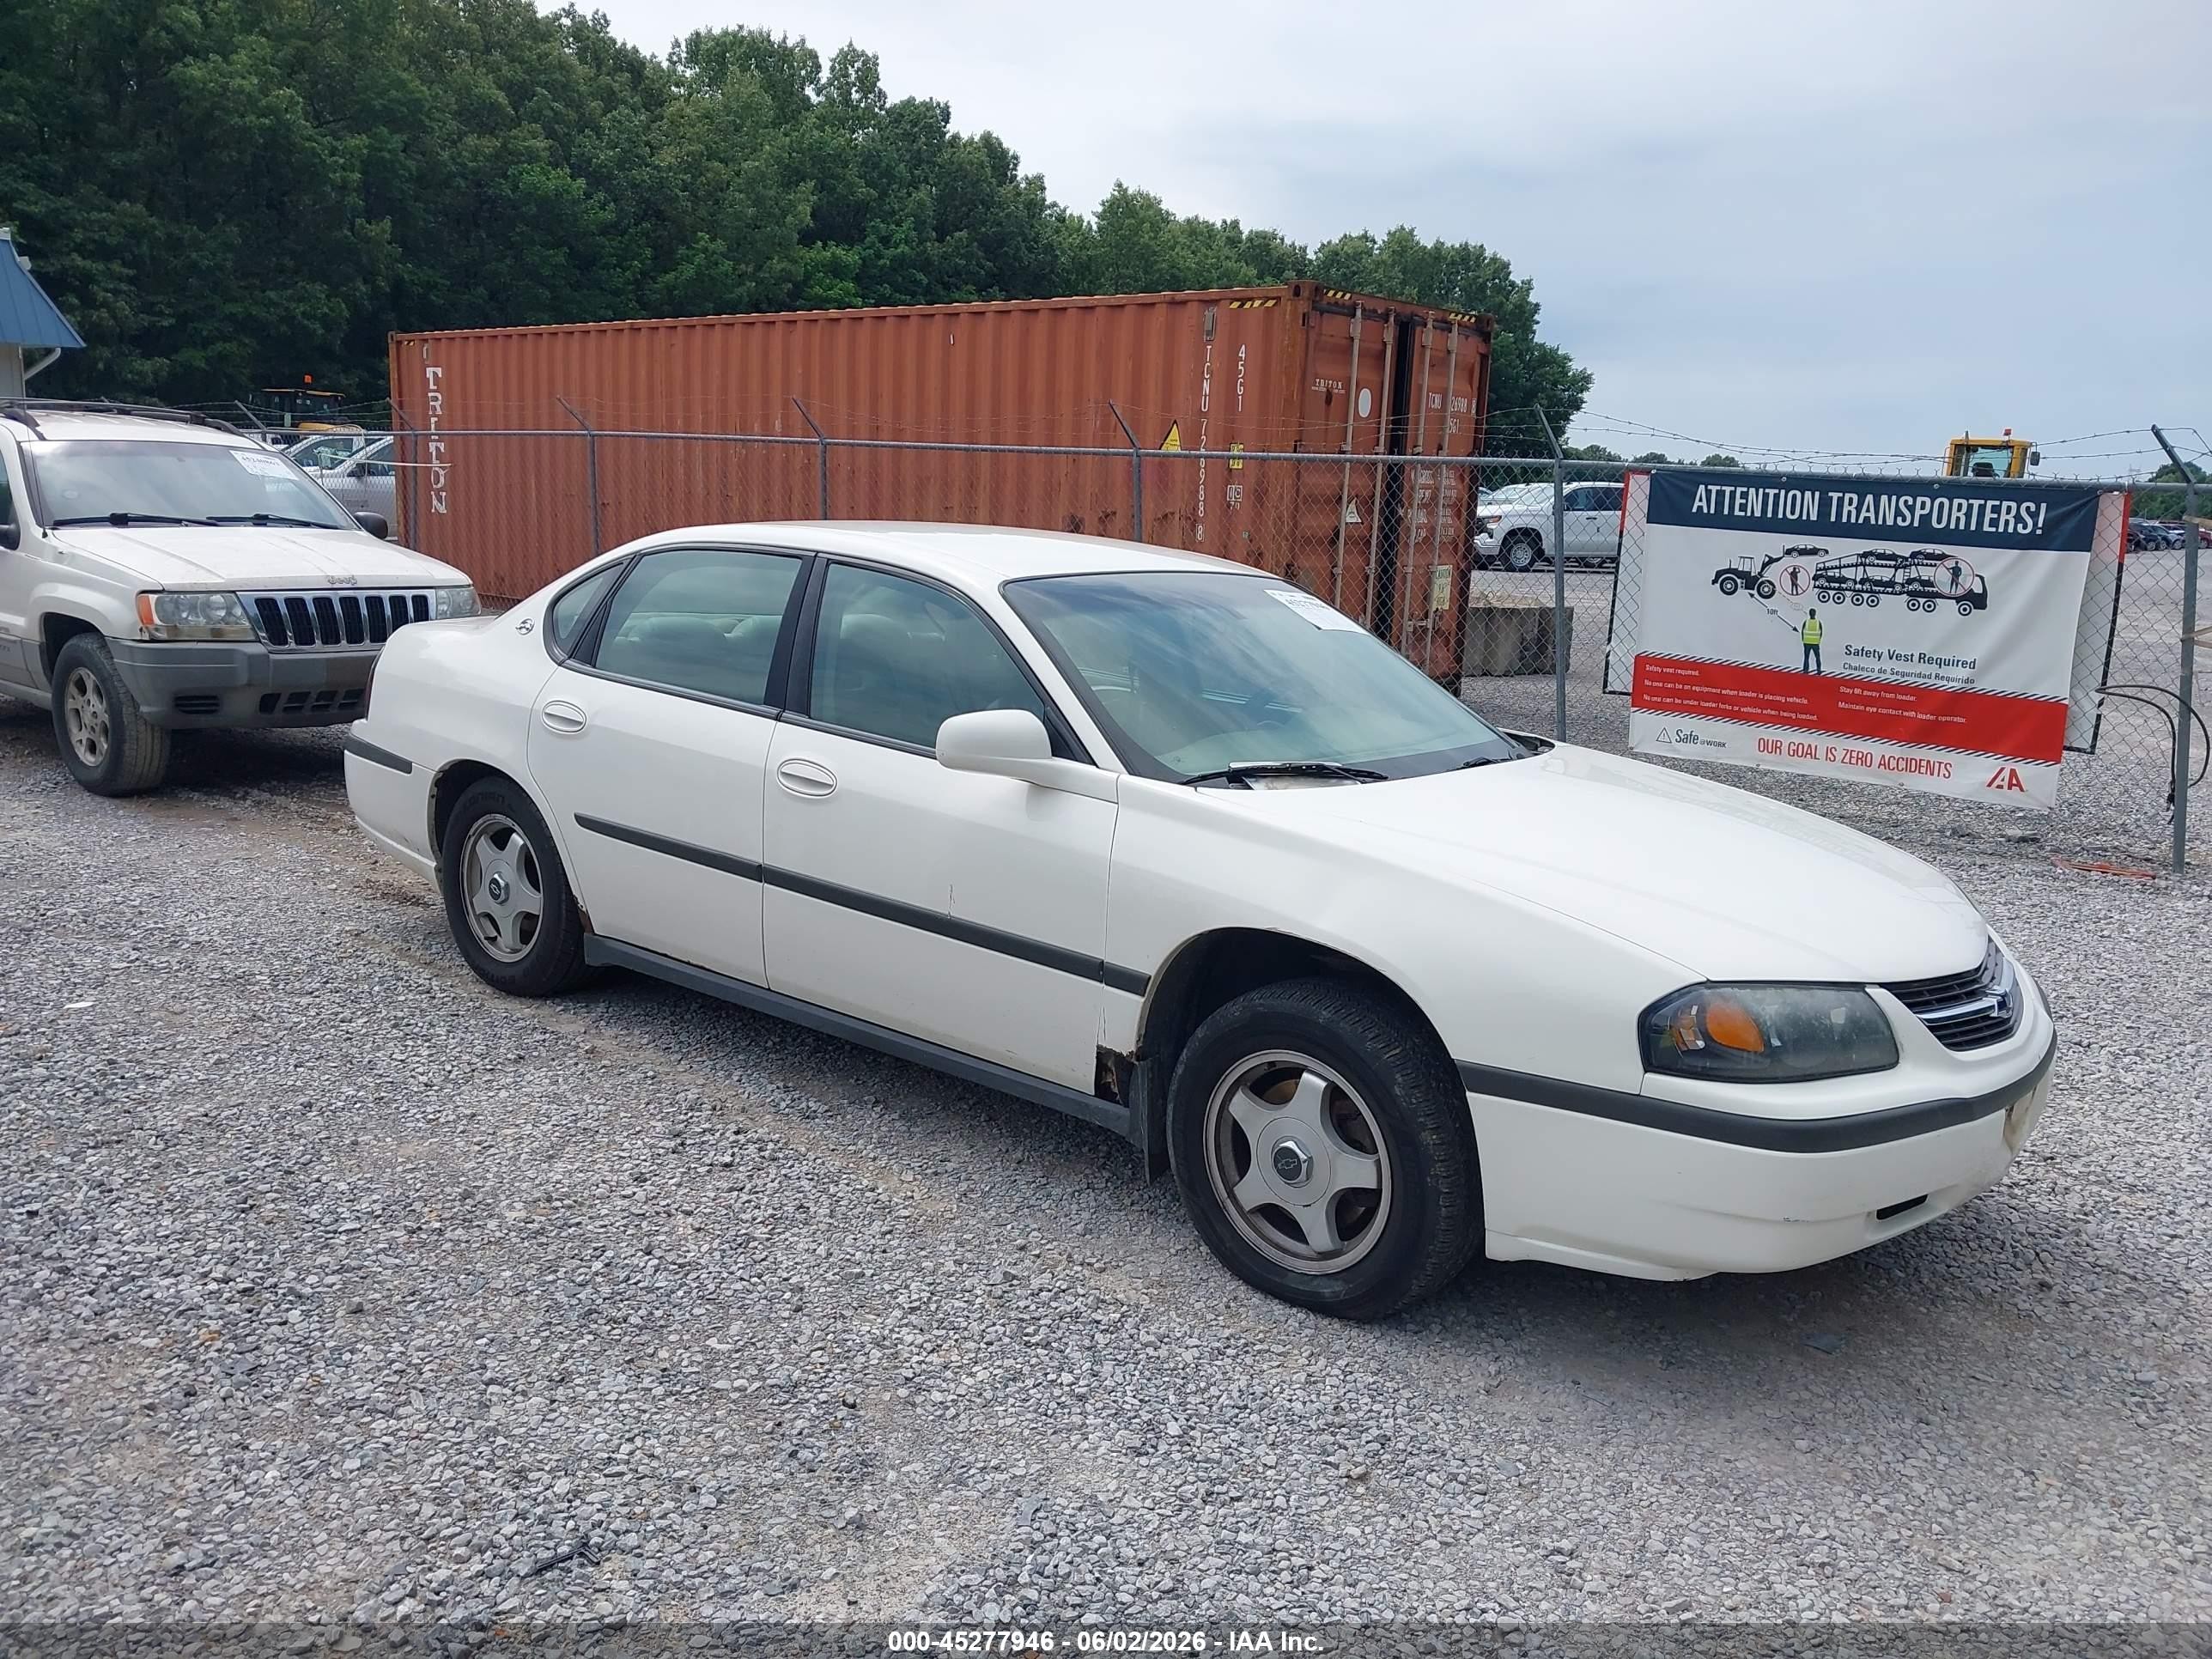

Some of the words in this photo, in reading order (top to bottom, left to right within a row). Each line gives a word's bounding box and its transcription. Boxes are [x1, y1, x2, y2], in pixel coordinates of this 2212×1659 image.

[1237, 344, 1246, 412] 45G1
[426, 367, 447, 514] TRITON
[1692, 484, 1819, 521] ATTENTION
[1827, 491, 2047, 535] TRANSPORTERS!
[1645, 664, 1662, 673] Safety
[1843, 662, 1875, 673] Chaleco
[1877, 665, 1887, 675] de
[1889, 667, 1932, 681] Seguridad
[1934, 672, 1975, 685] Requirido
[1844, 644, 1883, 661] Safety
[1887, 648, 1914, 663] Vest
[1917, 653, 1977, 670] Required
[1758, 738, 1783, 756] OUR
[1787, 742, 1820, 761] GOAL
[1825, 746, 1837, 763] IS
[1840, 748, 1873, 768] ZERO
[1877, 754, 1953, 780] ACCIDENTS
